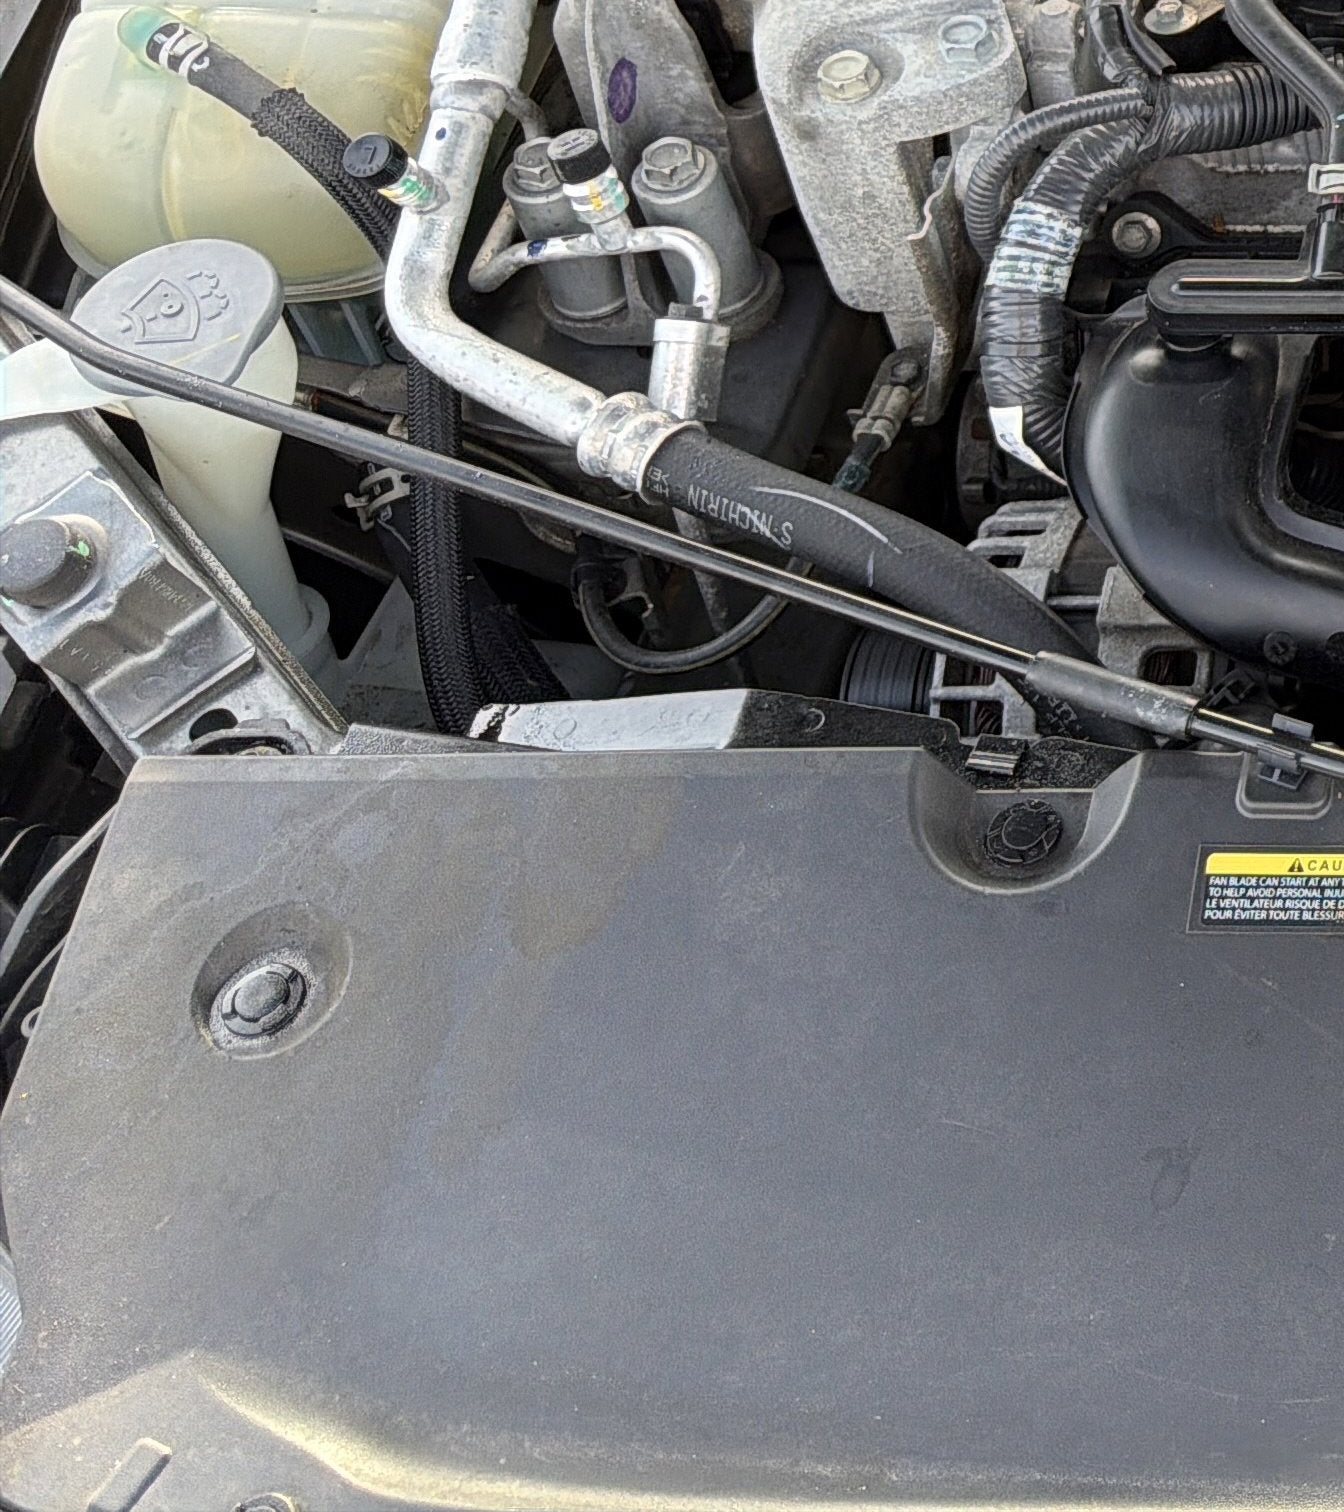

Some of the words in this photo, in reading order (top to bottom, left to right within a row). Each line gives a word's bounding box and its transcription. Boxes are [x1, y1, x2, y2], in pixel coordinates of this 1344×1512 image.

[1209, 877, 1228, 887] FAN
[1229, 877, 1258, 887] BLADE
[1259, 877, 1279, 887] CAN
[1280, 877, 1306, 887] START
[1307, 877, 1319, 887] AT
[1320, 877, 1339, 887] ANY
[1209, 888, 1221, 898] TO
[1223, 888, 1245, 898] HELP
[1246, 888, 1275, 898] AVOID
[1276, 888, 1322, 898] PERSONAL
[1206, 898, 1218, 908] LE
[1219, 898, 1283, 908] VENTILATEUR
[1285, 898, 1320, 908] RISQUE
[1322, 898, 1336, 908] DE
[1204, 909, 1232, 920] POUR
[1234, 909, 1267, 920] ÉVITER
[1269, 909, 1300, 920] TOUTE
